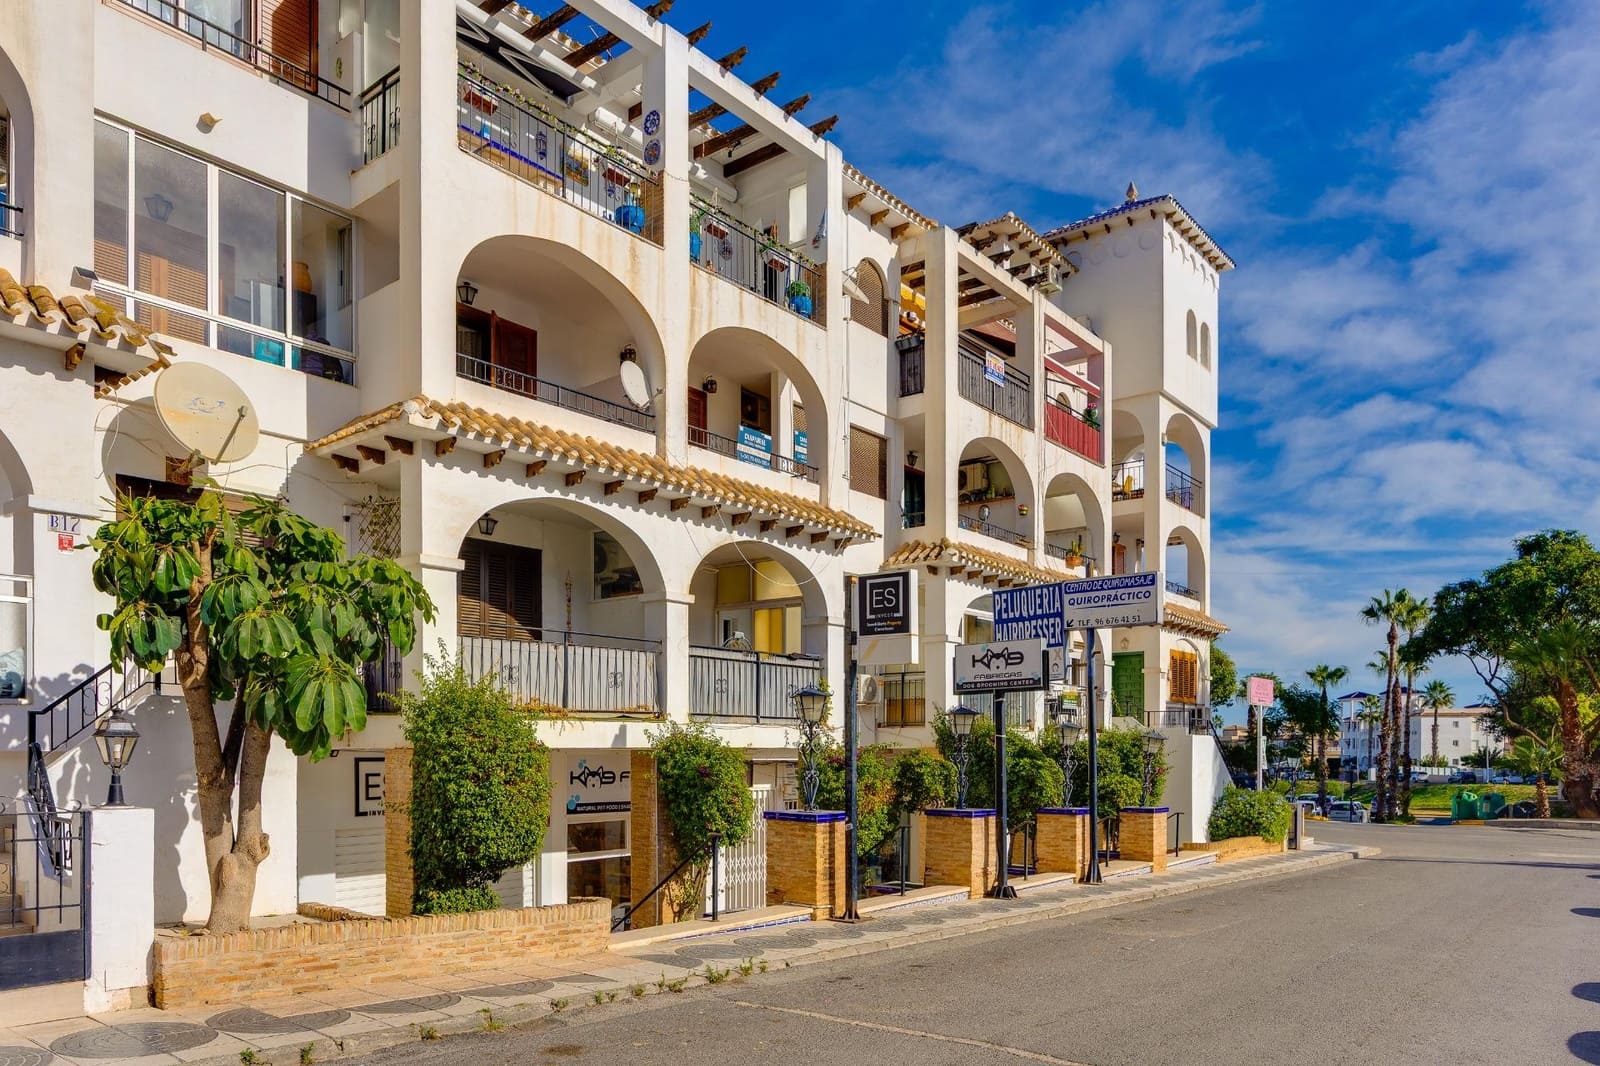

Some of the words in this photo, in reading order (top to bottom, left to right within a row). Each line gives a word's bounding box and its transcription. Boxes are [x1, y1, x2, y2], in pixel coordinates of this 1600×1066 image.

[50, 514, 81, 532] B17
[1066, 581, 1092, 593] CENTRO
[1093, 580, 1102, 590] DE
[1103, 574, 1153, 590] QUIROMASAJE
[872, 587, 896, 608] ES
[994, 586, 1062, 620] PELUQUERIA
[1068, 590, 1152, 606] QUIROPRÁCTICO
[1105, 616, 1120, 625] 676
[973, 671, 1023, 680] FABREGAS
